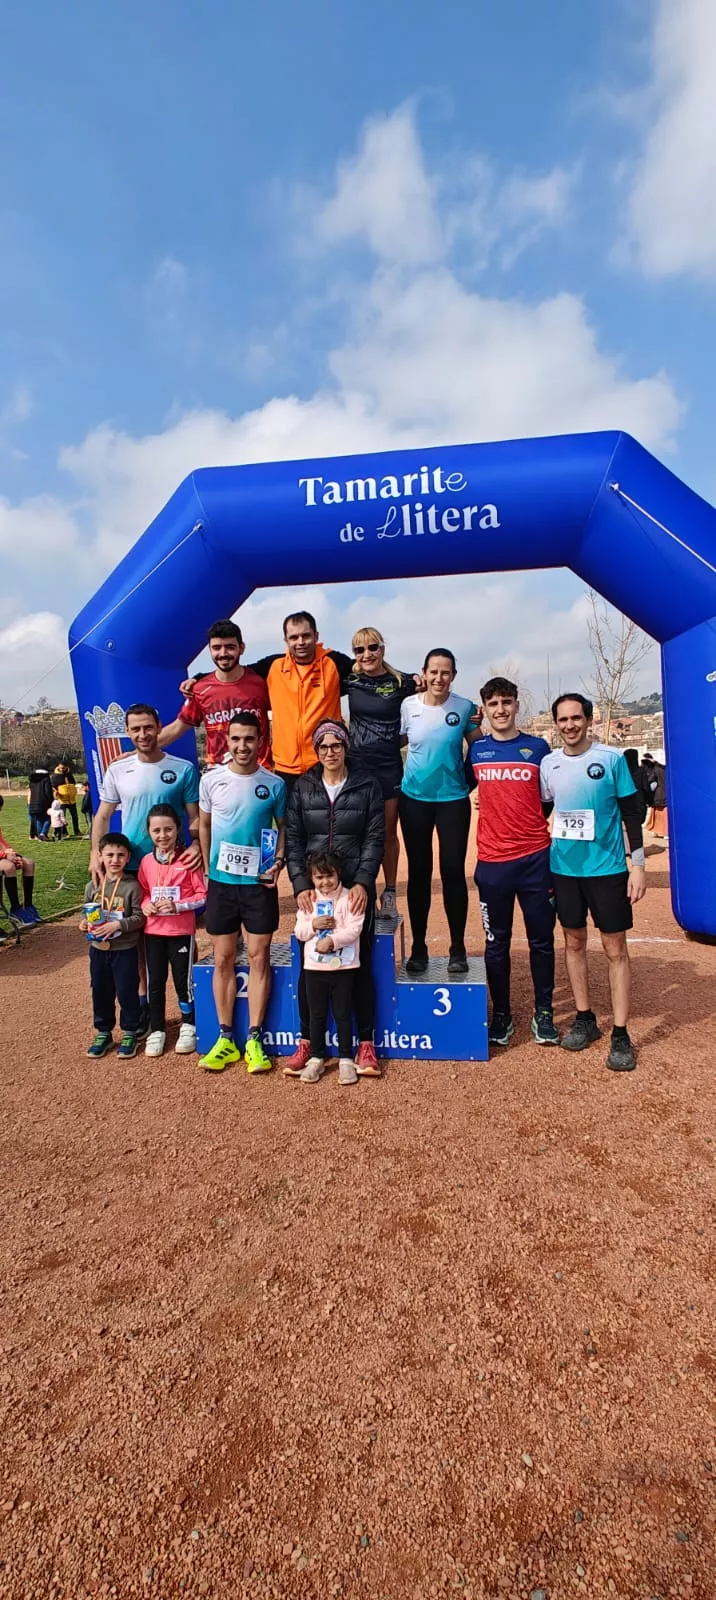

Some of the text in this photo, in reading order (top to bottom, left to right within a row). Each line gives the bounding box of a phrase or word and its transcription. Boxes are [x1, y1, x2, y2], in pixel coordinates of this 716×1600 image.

[299, 466, 467, 506] Tamarite
[339, 523, 365, 543] de
[563, 819, 584, 829] 129
[227, 853, 250, 865] 095
[235, 971, 249, 997] 2
[432, 987, 452, 1016] 3
